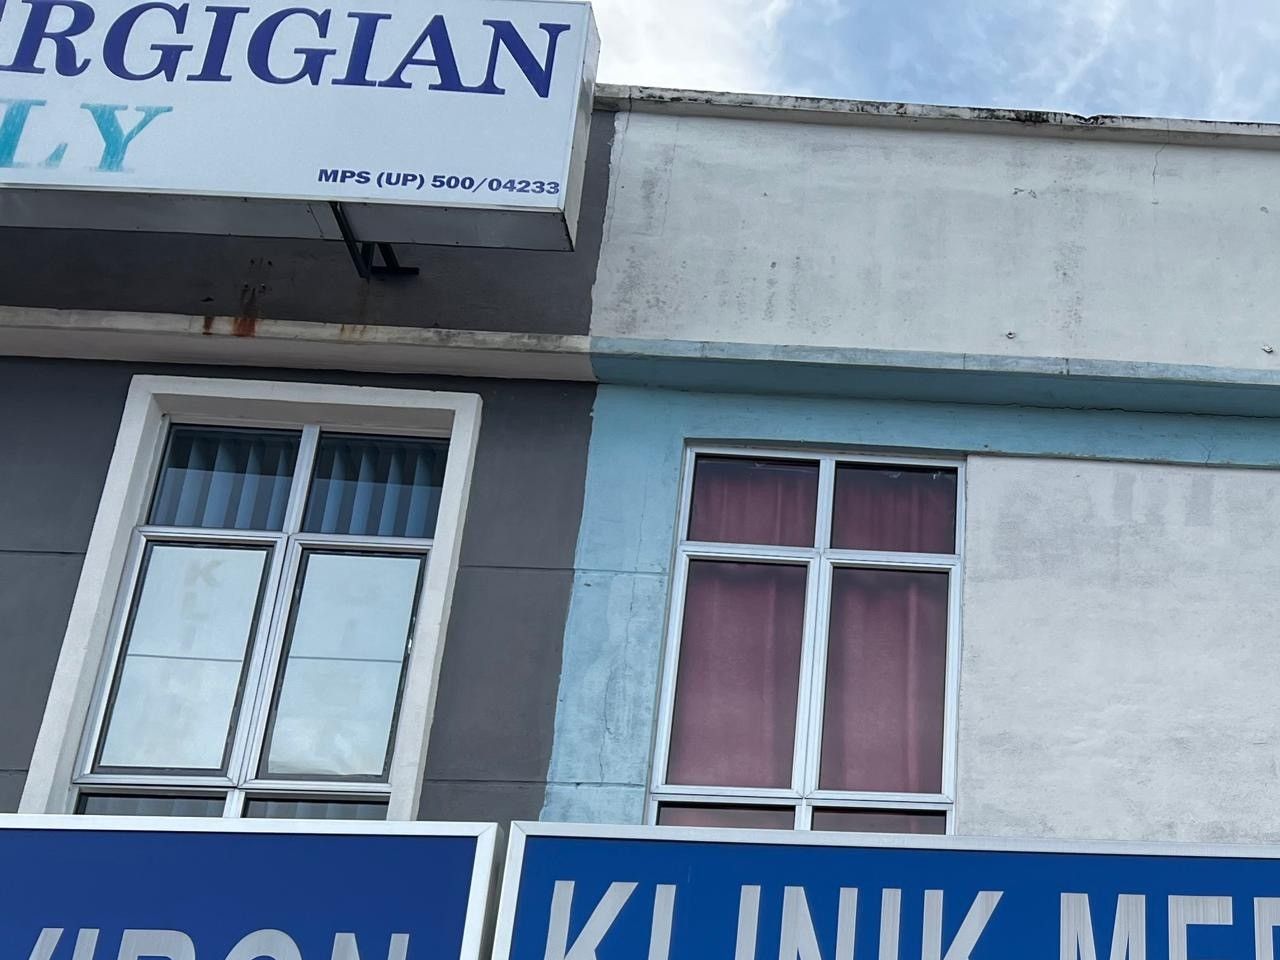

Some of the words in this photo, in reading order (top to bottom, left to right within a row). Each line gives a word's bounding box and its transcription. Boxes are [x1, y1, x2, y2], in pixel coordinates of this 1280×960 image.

[0, 0, 570, 98] RGIGIAN
[317, 168, 371, 185] MPS
[376, 171, 426, 191] (UP)
[430, 174, 561, 195] 500/04233
